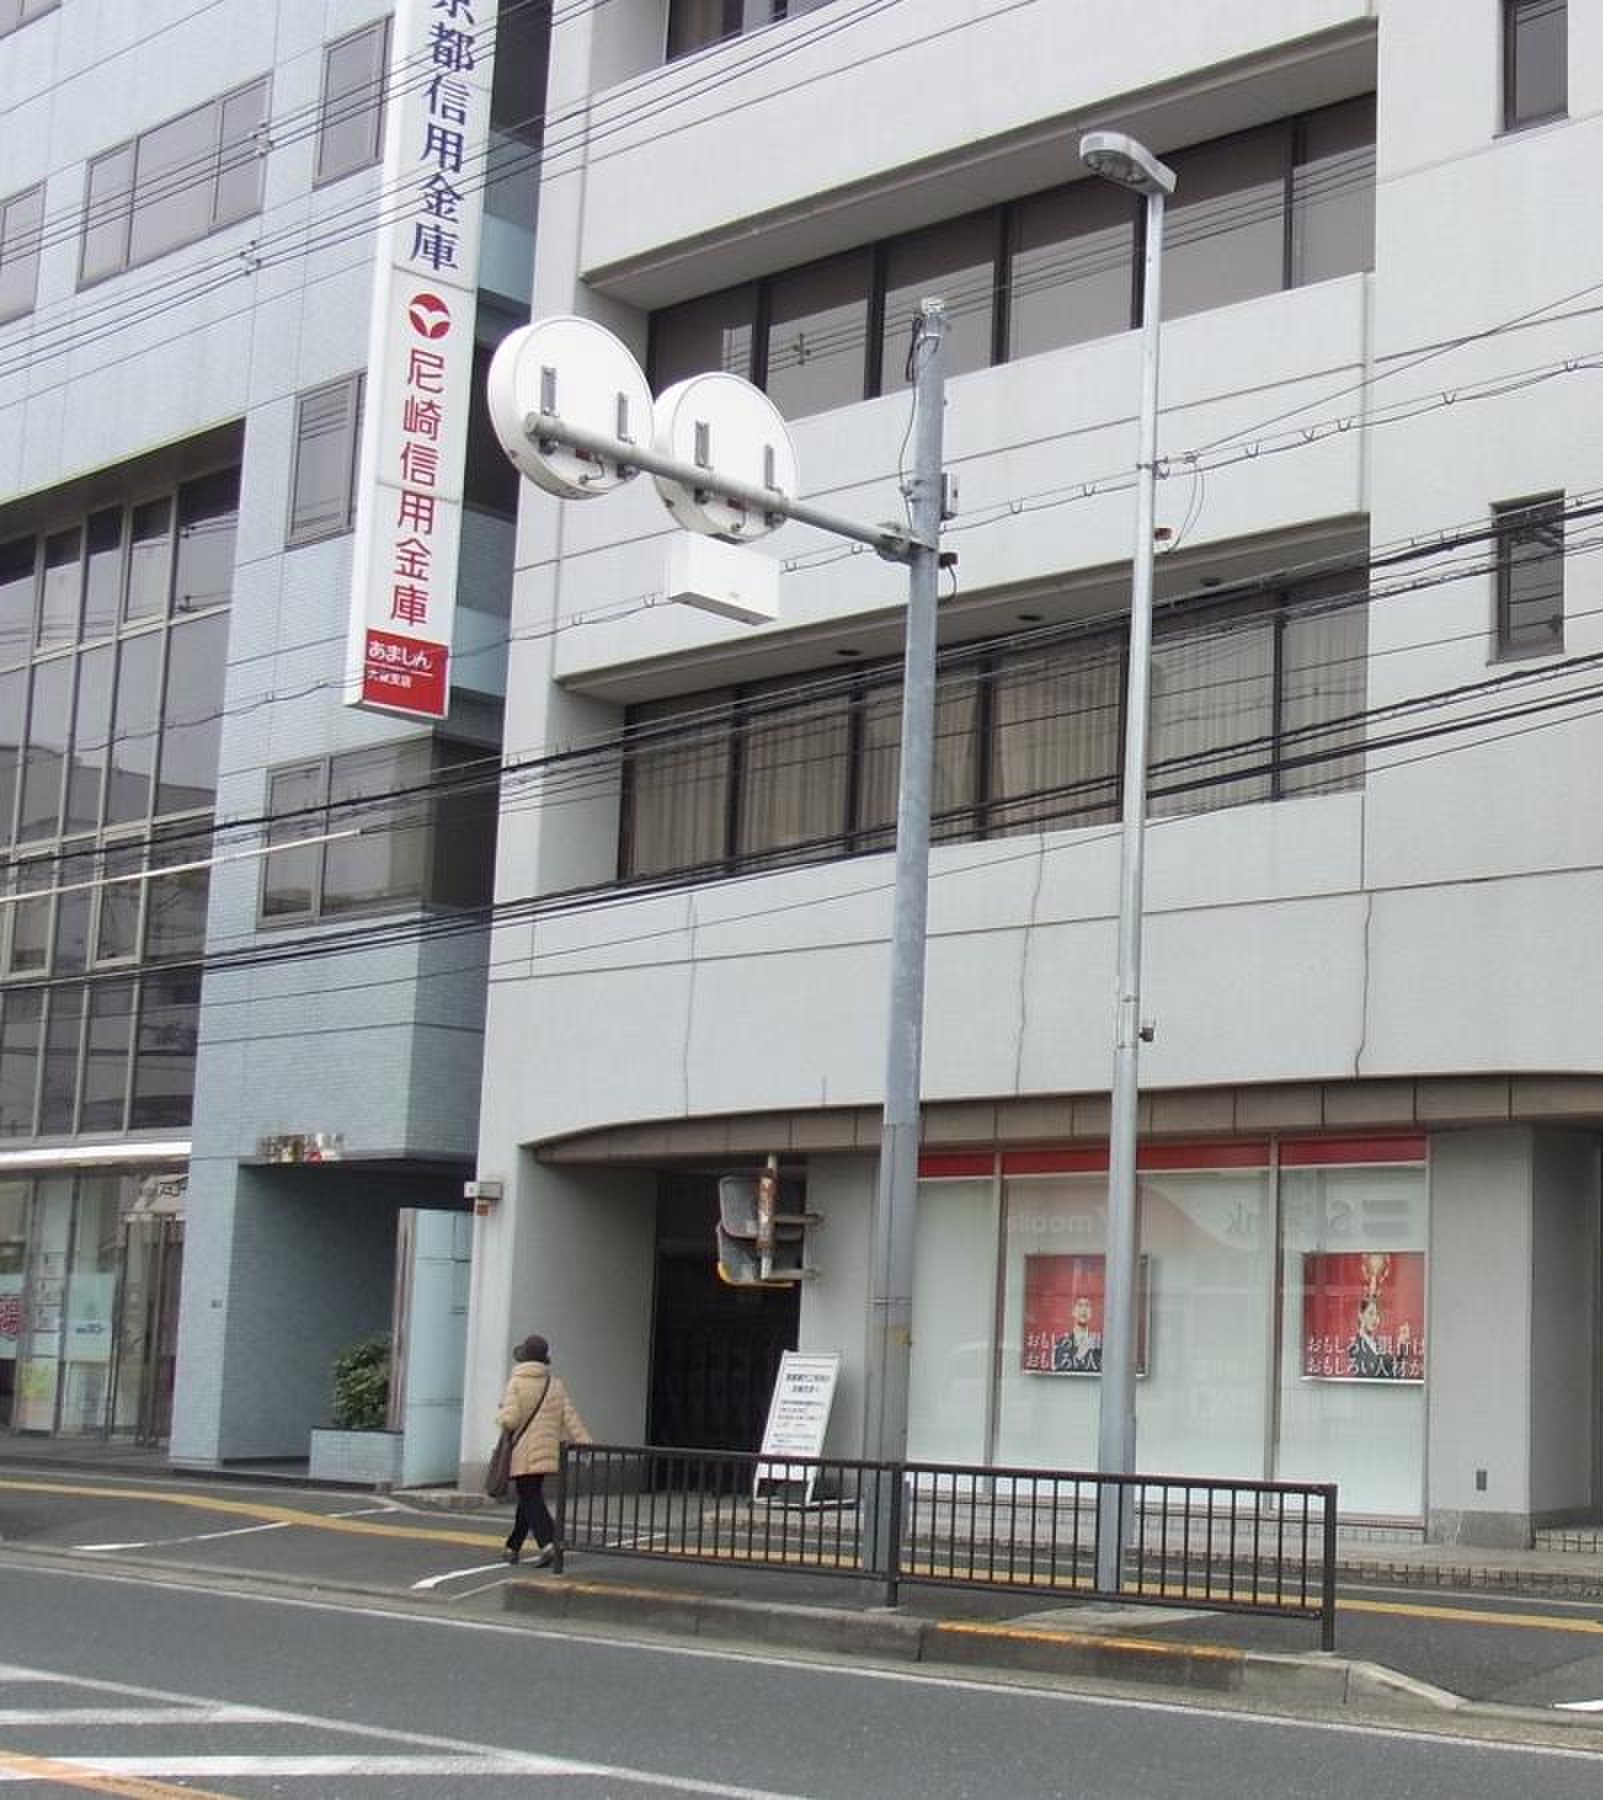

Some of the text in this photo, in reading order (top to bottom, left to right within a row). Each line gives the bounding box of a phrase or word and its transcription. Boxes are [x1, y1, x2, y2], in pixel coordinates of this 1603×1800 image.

[390, 347, 446, 628] 尼崎信用金庫
[368, 639, 433, 670] あましん
